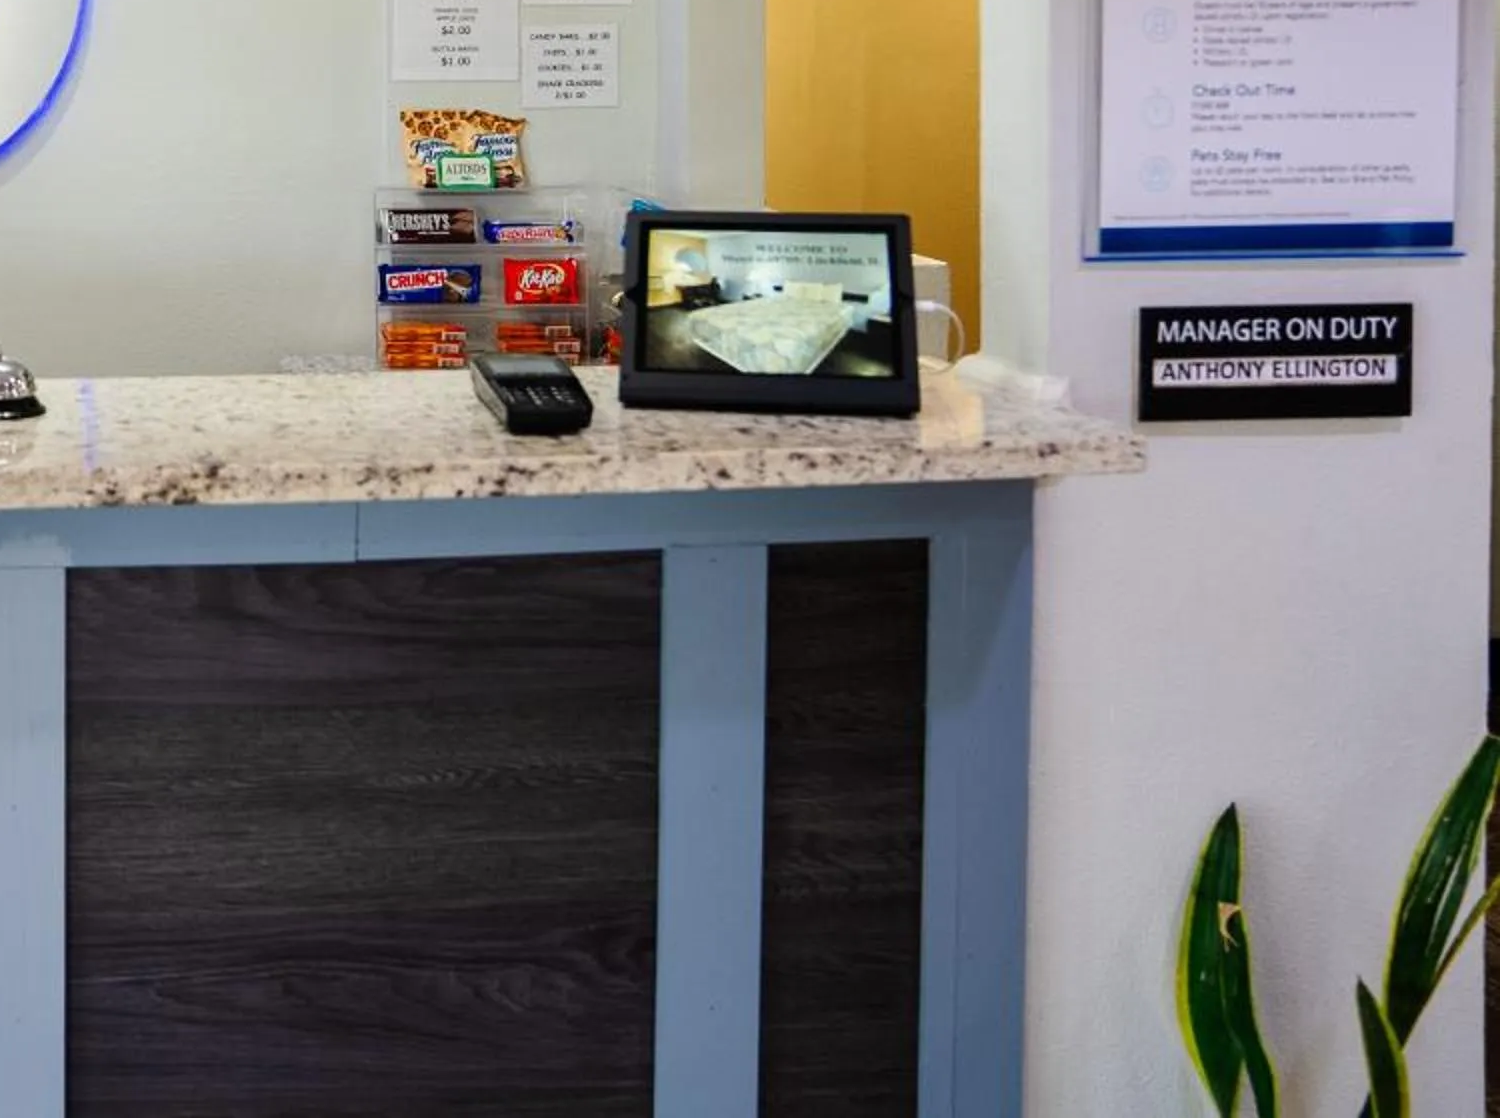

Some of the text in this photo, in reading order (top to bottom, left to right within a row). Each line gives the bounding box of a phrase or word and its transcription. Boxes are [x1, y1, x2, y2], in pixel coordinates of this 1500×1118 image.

[1192, 84, 1296, 97] Check Out Time
[1191, 148, 1282, 165] Pets Stay Free
[390, 212, 451, 231] HERSHEY'S
[388, 271, 446, 289] CRUNCH
[1157, 317, 1397, 343] MANAGER ON DUTY
[1161, 358, 1386, 381] ANTHONY ELLINGTON
